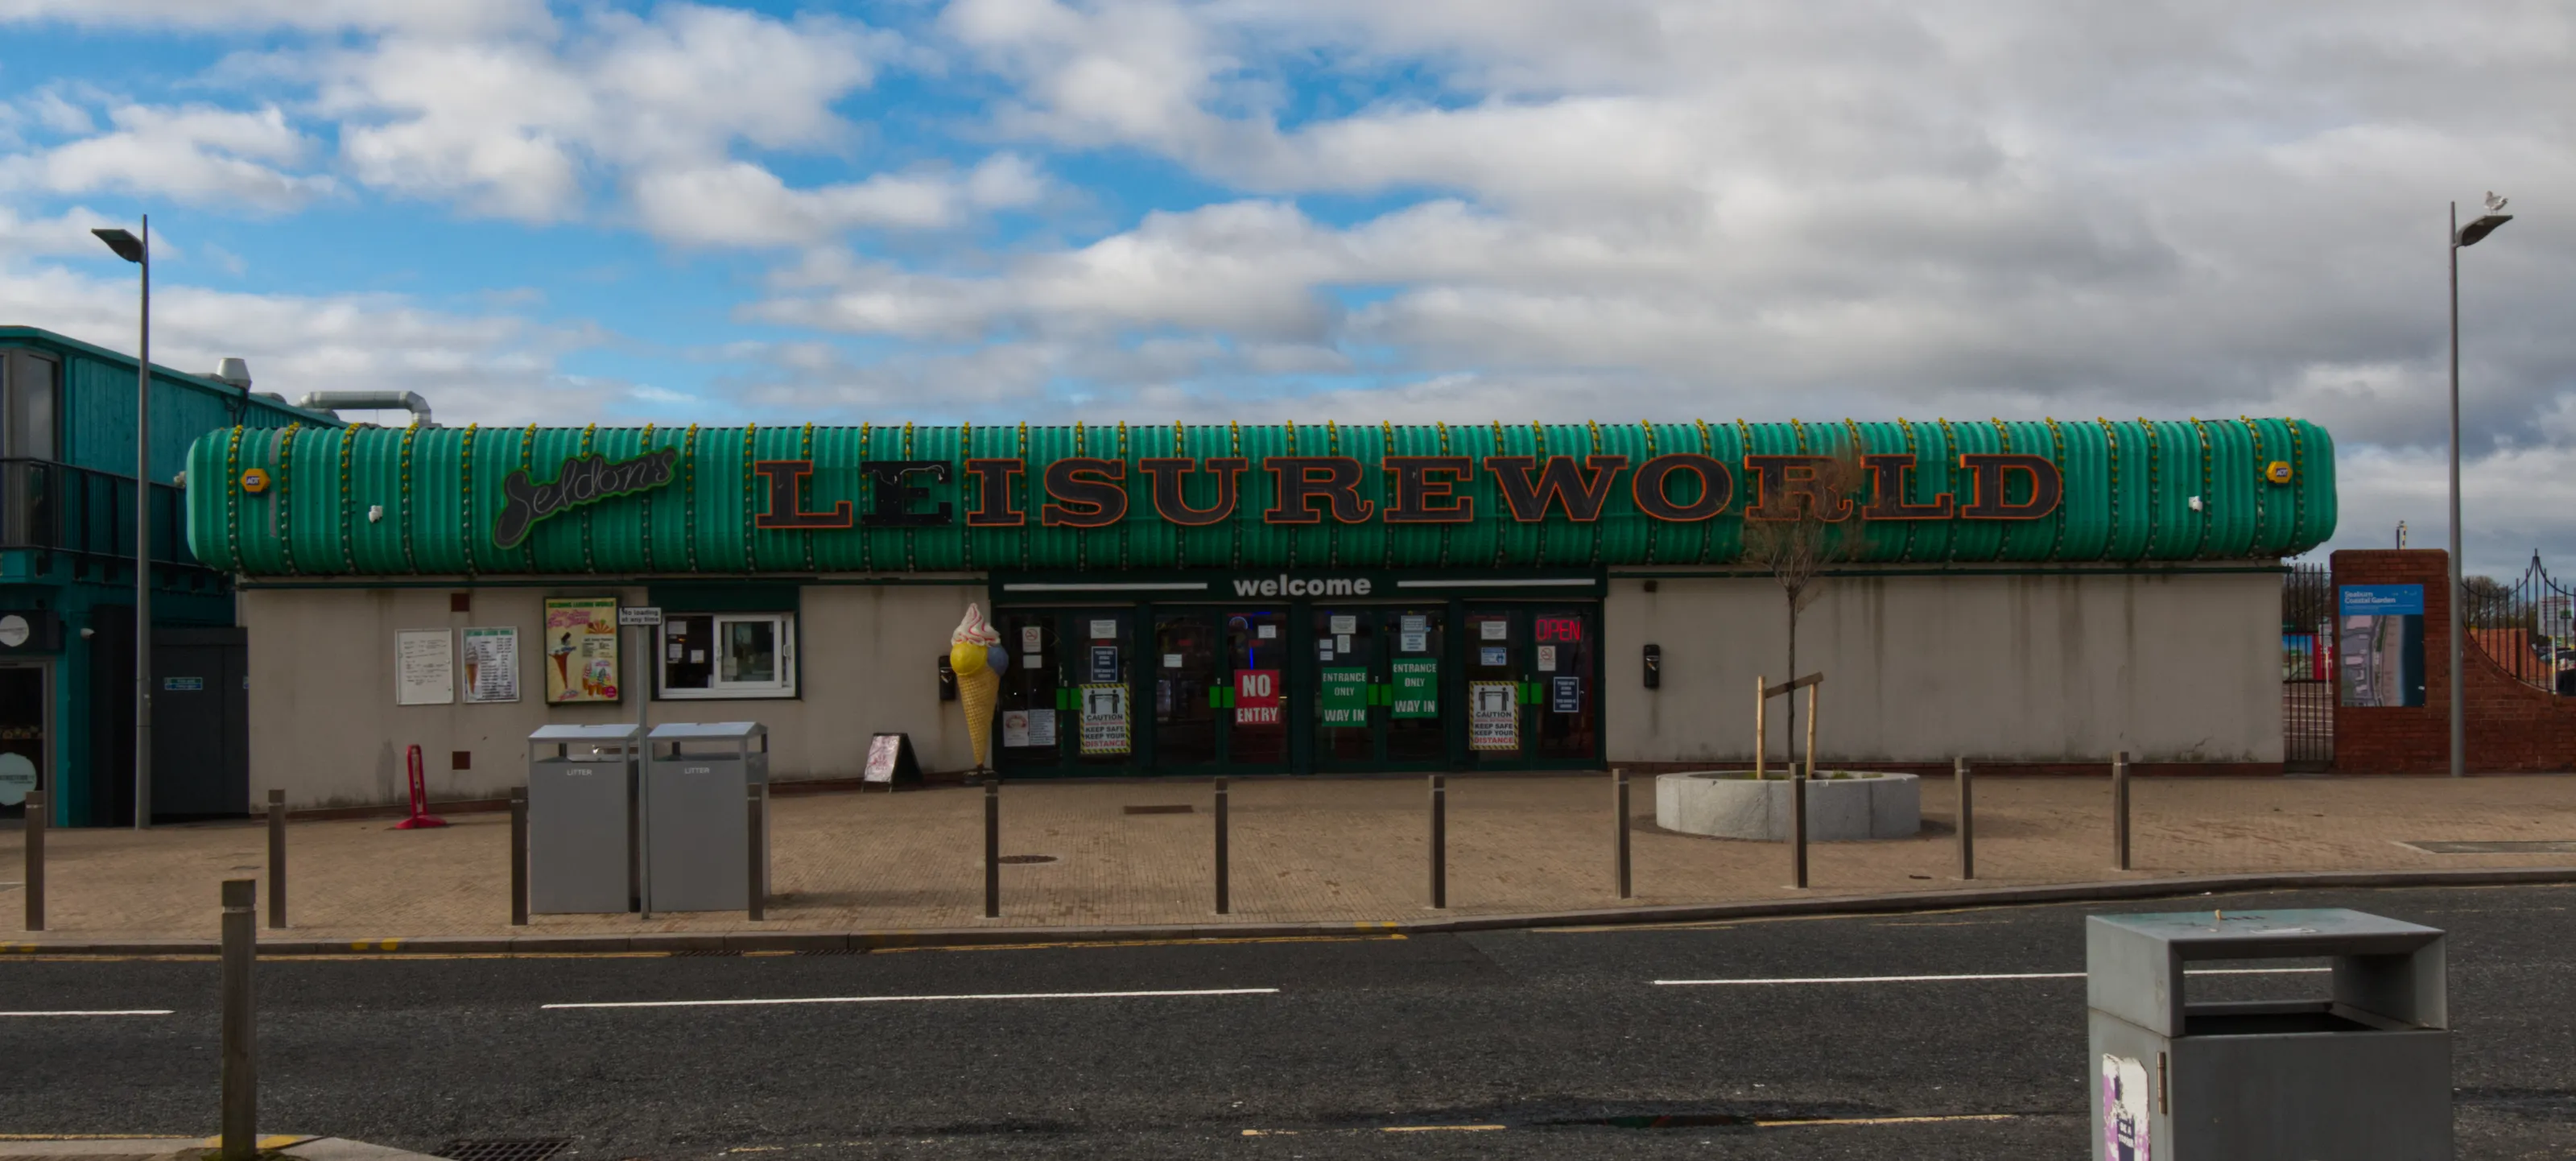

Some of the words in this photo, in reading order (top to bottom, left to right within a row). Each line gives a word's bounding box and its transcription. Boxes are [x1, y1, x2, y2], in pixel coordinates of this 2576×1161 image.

[2277, 469, 2288, 477] ADT
[246, 477, 259, 485] ADT
[754, 452, 2062, 528] LEISUREWORLD
[497, 451, 677, 543] Seldon's
[1233, 573, 1372, 597] welcome
[2371, 596, 2396, 604] Garden
[634, 609, 658, 617] loading
[1535, 618, 1582, 642] OPEN
[1393, 663, 1437, 673] ENTRANCE
[1323, 672, 1366, 683] ENTRANCE
[1405, 677, 1425, 688] ONLY
[1242, 674, 1271, 697] NO
[1334, 687, 1355, 696] ONLY
[1394, 700, 1420, 713] WAY
[1423, 700, 1435, 713] IN
[1236, 707, 1278, 722] ENTRY
[1324, 709, 1350, 722] WAY
[1352, 709, 1365, 721] IN
[1084, 739, 1126, 747] DISTANCE
